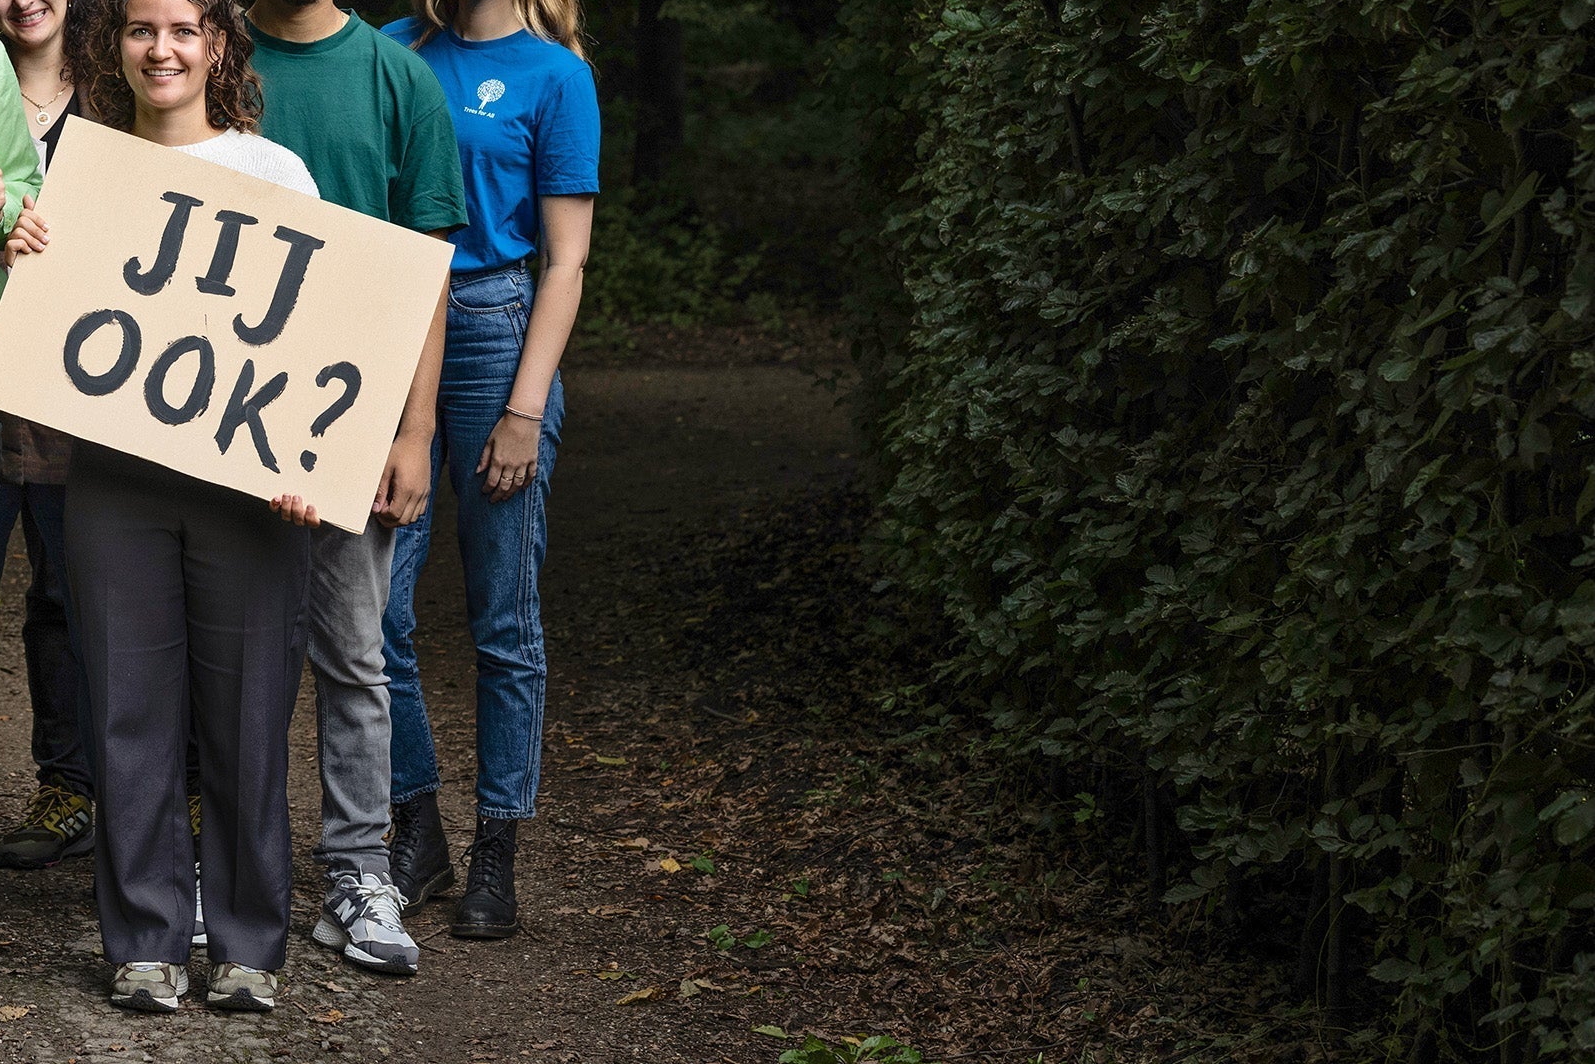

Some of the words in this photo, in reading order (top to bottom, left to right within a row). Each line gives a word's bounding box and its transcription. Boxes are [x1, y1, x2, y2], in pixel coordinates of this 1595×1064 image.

[464, 106, 478, 115] Trees
[122, 190, 326, 347] JIJ
[62, 307, 363, 474] OOK?
